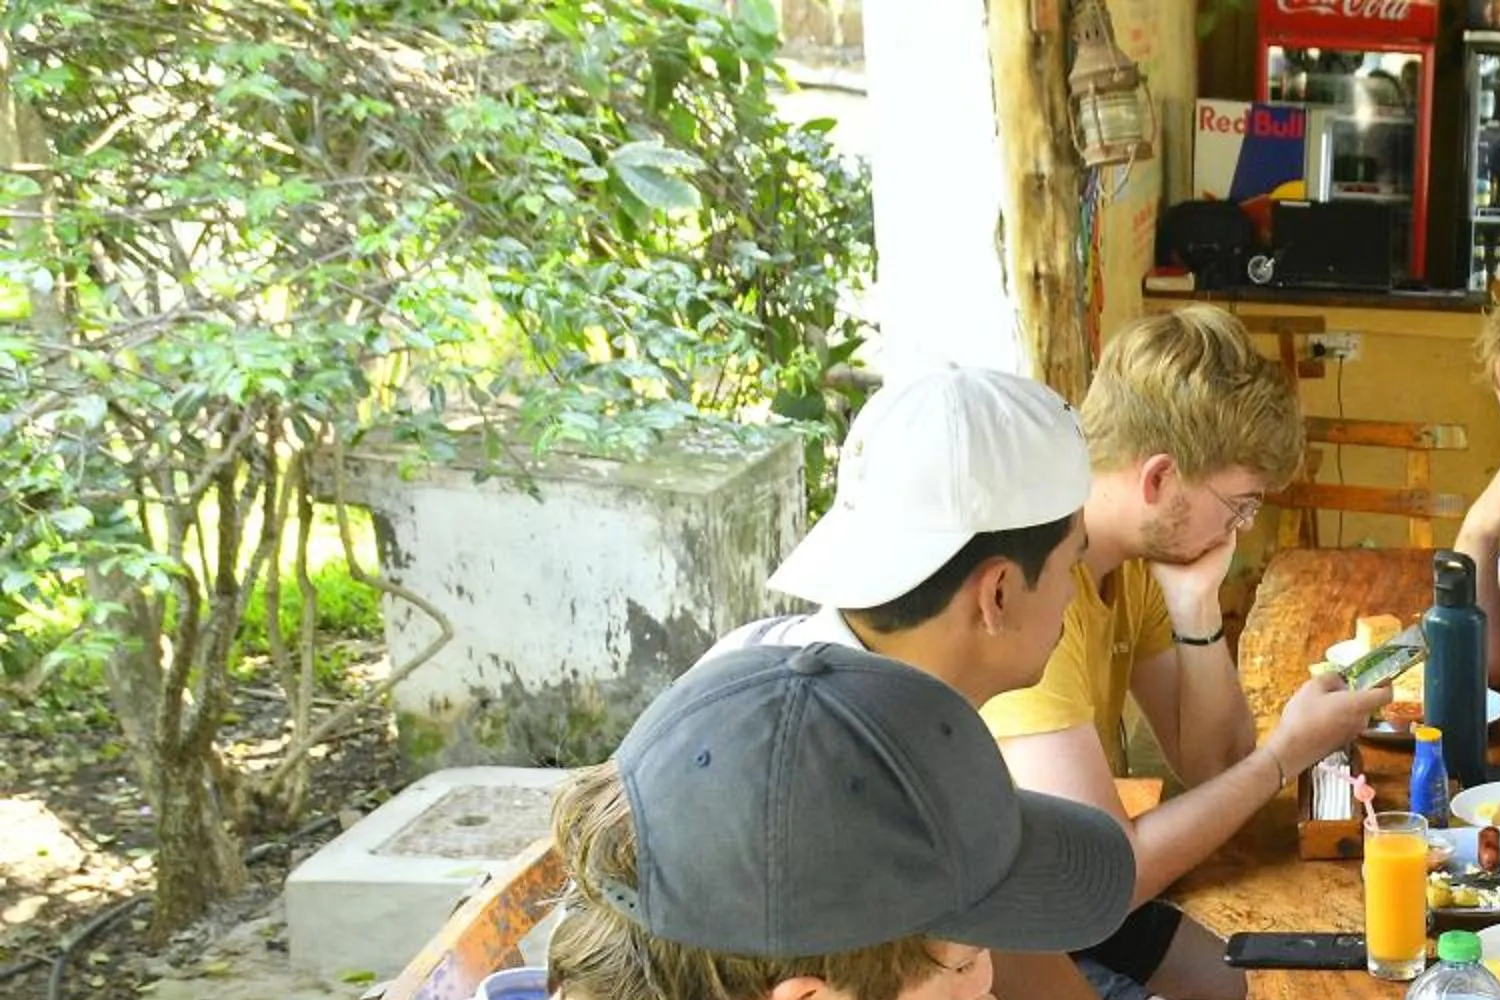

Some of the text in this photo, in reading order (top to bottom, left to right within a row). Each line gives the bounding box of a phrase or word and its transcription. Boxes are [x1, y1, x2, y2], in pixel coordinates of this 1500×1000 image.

[1277, 0, 1407, 20] CCola
[1200, 105, 1303, 138] Red Bull
